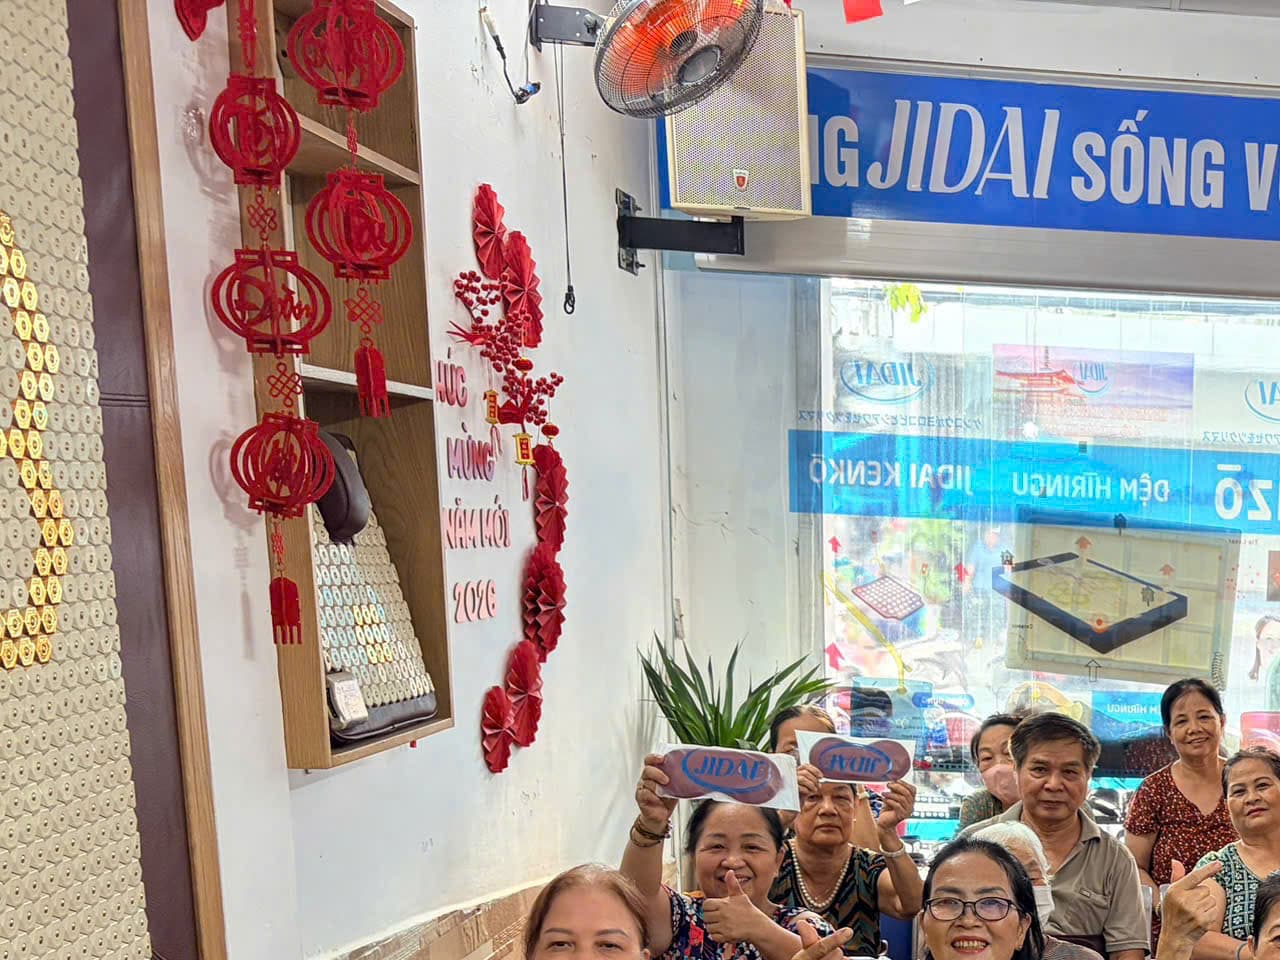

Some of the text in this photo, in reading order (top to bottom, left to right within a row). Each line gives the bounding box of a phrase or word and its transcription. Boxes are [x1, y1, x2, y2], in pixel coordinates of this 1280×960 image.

[867, 99, 1060, 200] JIDAI
[1071, 109, 1226, 210] SỐNG
[442, 494, 512, 549] NĂM MỚI
[453, 578, 497, 625] 2026
